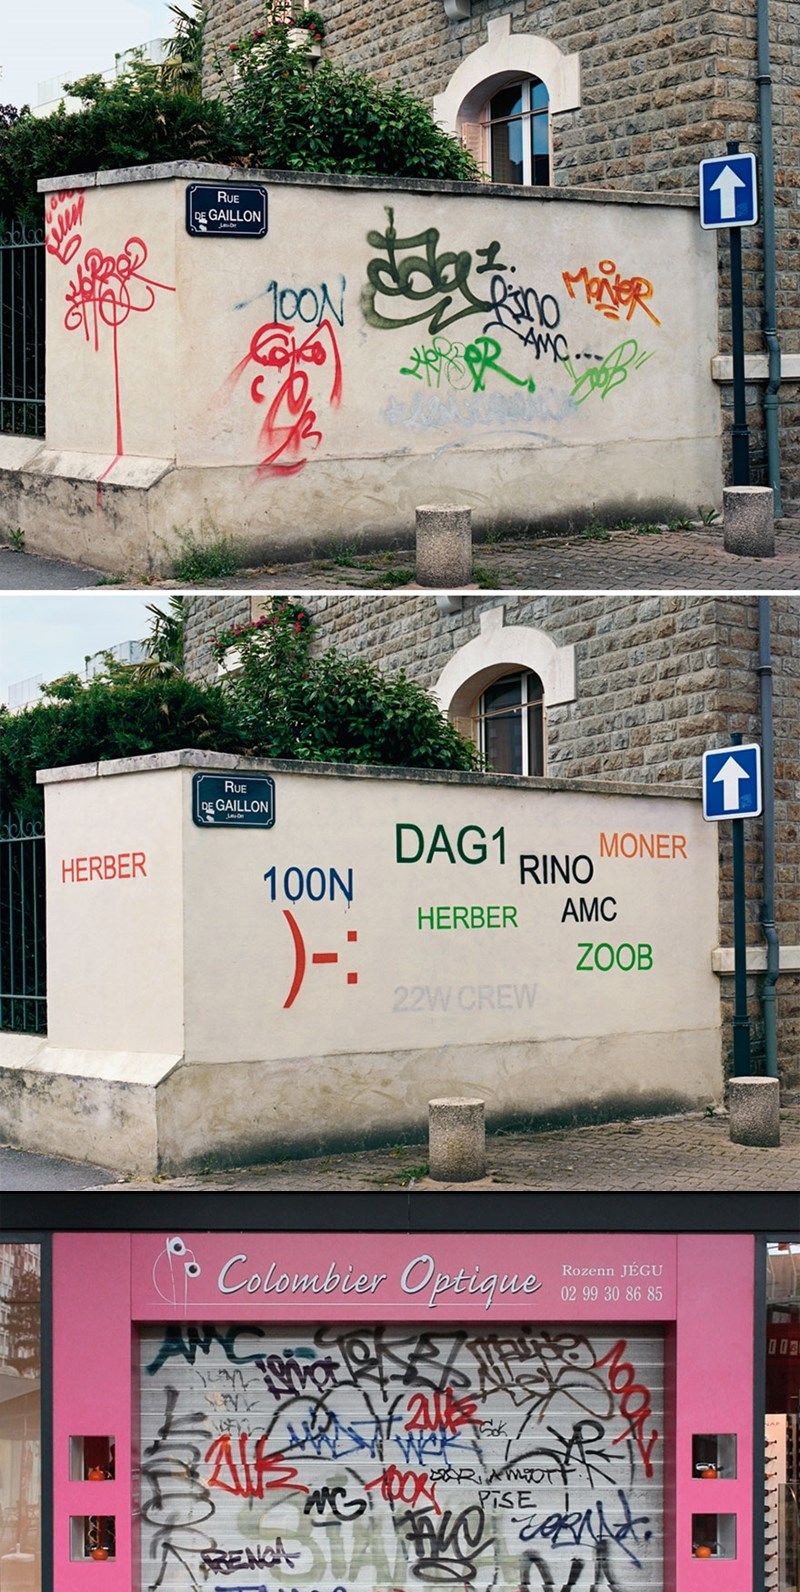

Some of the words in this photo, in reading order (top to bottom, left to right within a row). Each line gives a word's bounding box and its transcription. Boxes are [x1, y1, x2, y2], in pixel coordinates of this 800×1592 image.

[208, 208, 261, 222] GAILLON
[215, 798, 269, 813] GAILLON
[395, 823, 506, 865] DAG1
[599, 832, 688, 859] MONER
[61, 853, 147, 883] HERBER
[519, 855, 595, 885] RINO
[263, 866, 354, 902] 100N
[417, 906, 519, 930] HERBER
[560, 896, 618, 923] AMC
[576, 942, 654, 971] ZOOB
[456, 983, 539, 1010] CREW
[217, 1254, 387, 1296] Colombier
[400, 1254, 543, 1310] Optique
[561, 1264, 614, 1277] Rozenn
[620, 1261, 664, 1277] JÉGU
[561, 1286, 577, 1301] 02
[583, 1286, 599, 1301] 99
[604, 1286, 620, 1301] 30
[626, 1286, 642, 1301] 86
[647, 1286, 664, 1301] 85
